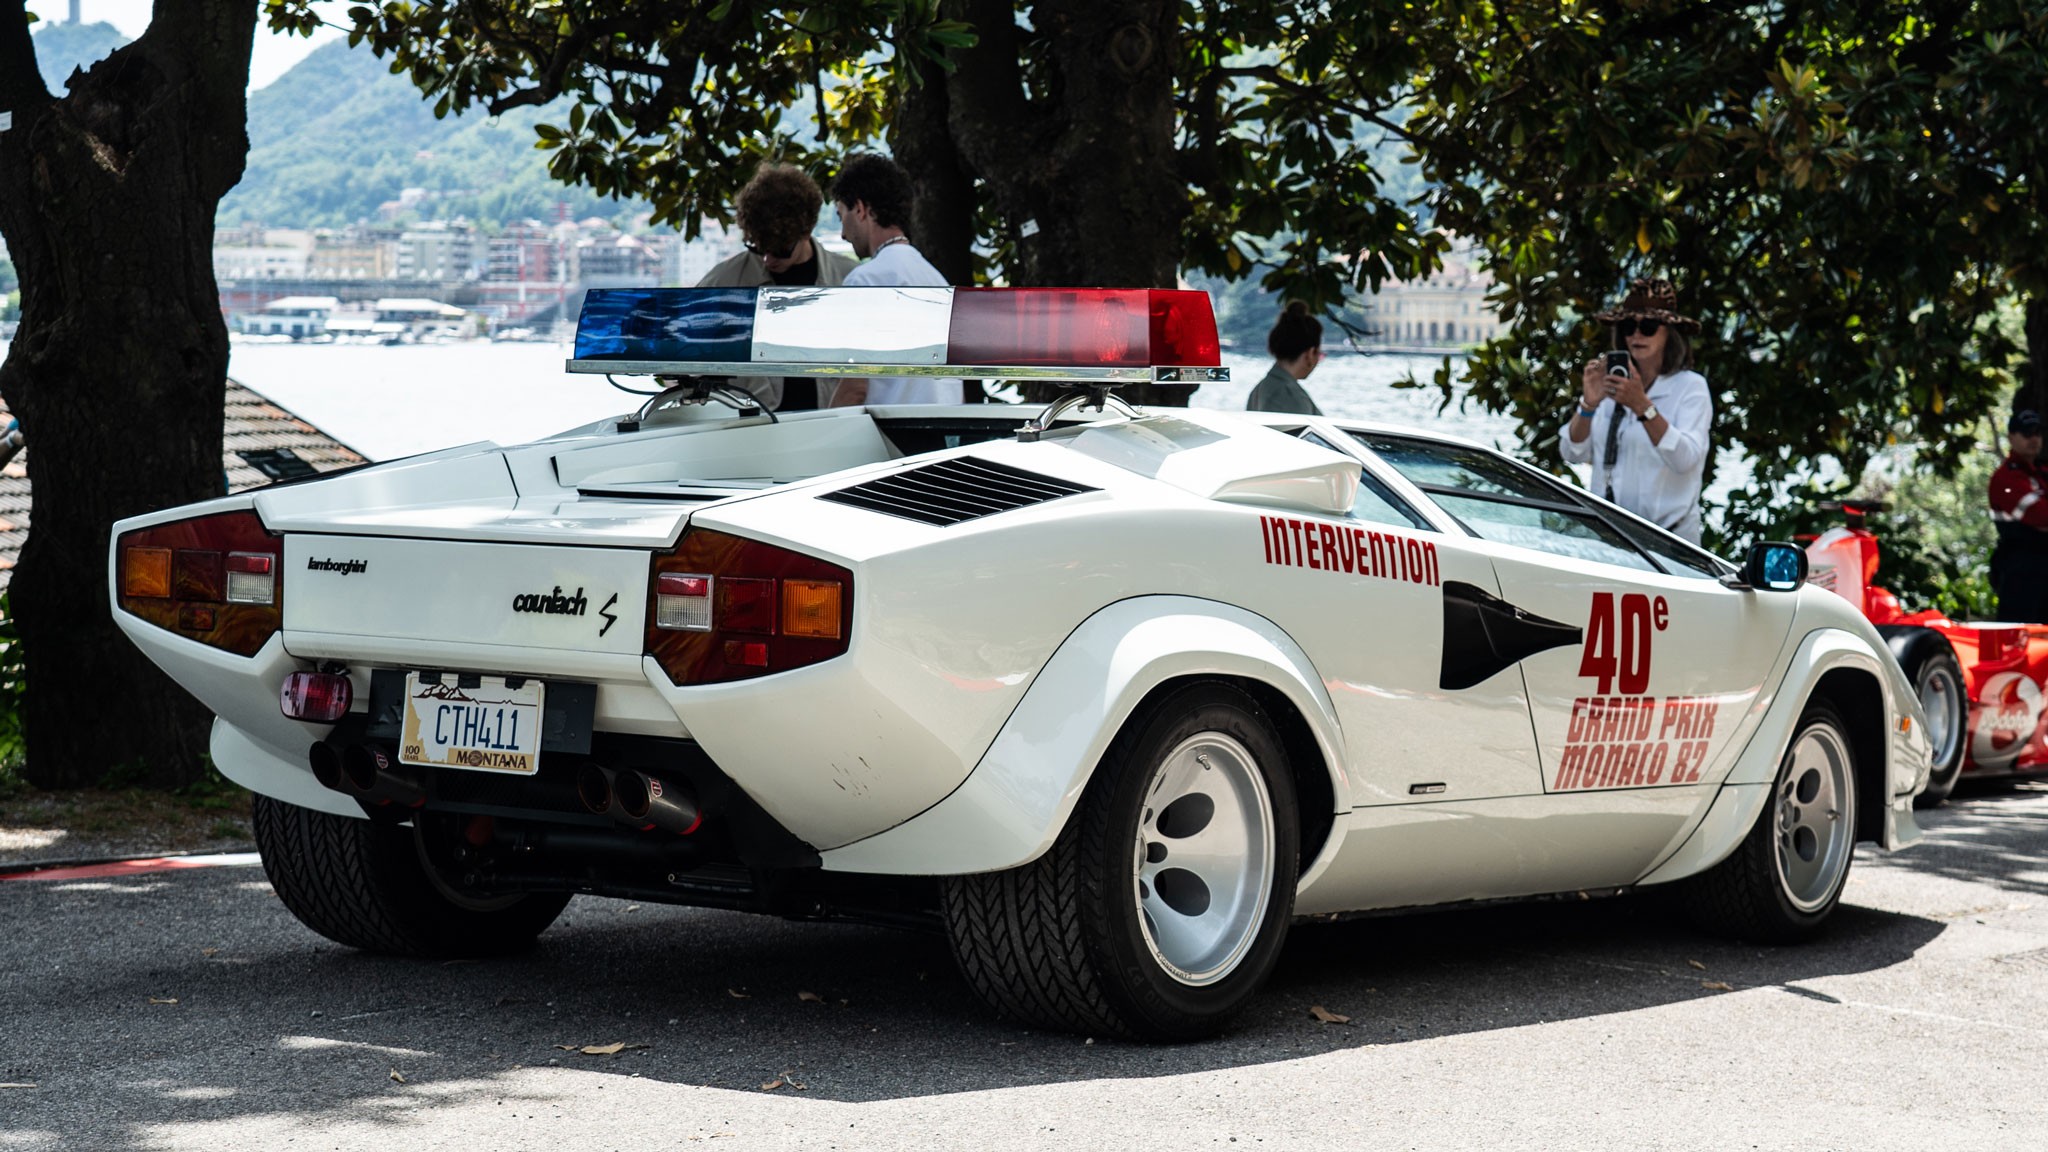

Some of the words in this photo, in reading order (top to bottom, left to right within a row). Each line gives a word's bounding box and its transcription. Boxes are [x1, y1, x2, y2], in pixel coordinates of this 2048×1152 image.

[307, 557, 368, 575] lamborghini
[1260, 516, 1440, 586] INTERVENTION
[513, 586, 587, 615] countach
[435, 704, 520, 750] CTH411
[1566, 697, 1656, 743] GRAND
[1659, 696, 1720, 740] PRIX
[405, 745, 420, 755] 100
[456, 750, 527, 769] MONTANA
[1553, 742, 1669, 790] MONACO
[1670, 741, 1709, 783] 82
